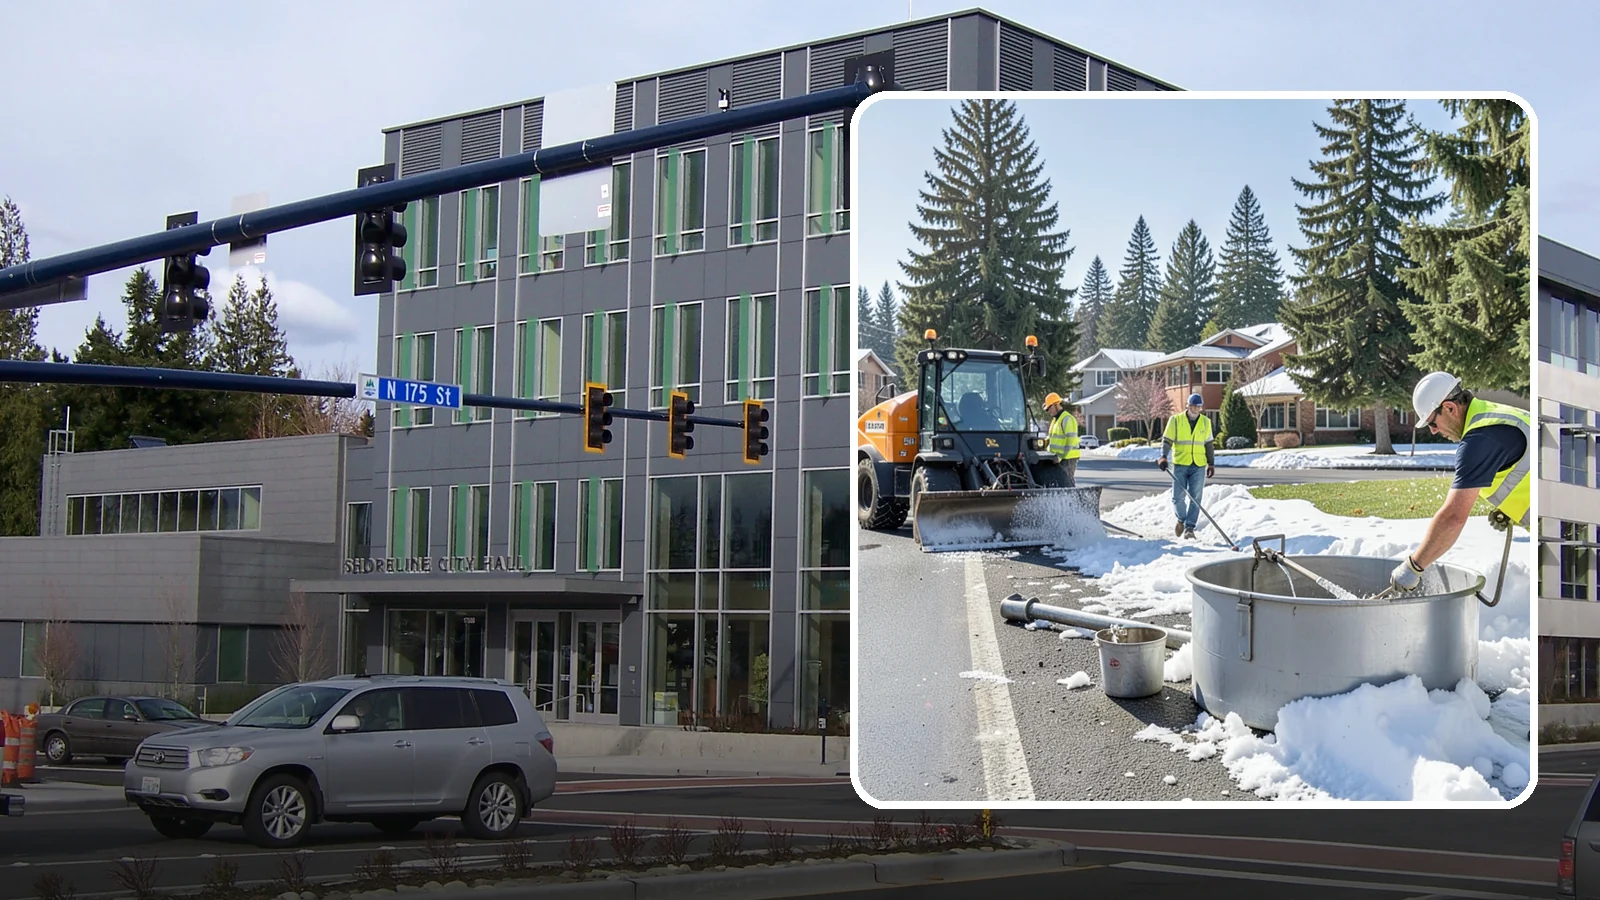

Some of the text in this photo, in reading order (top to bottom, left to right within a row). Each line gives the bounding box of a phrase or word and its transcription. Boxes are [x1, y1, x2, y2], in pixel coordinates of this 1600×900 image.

[387, 380, 452, 406] N 175 St
[344, 555, 526, 574] SHORELINE CITY HALL
